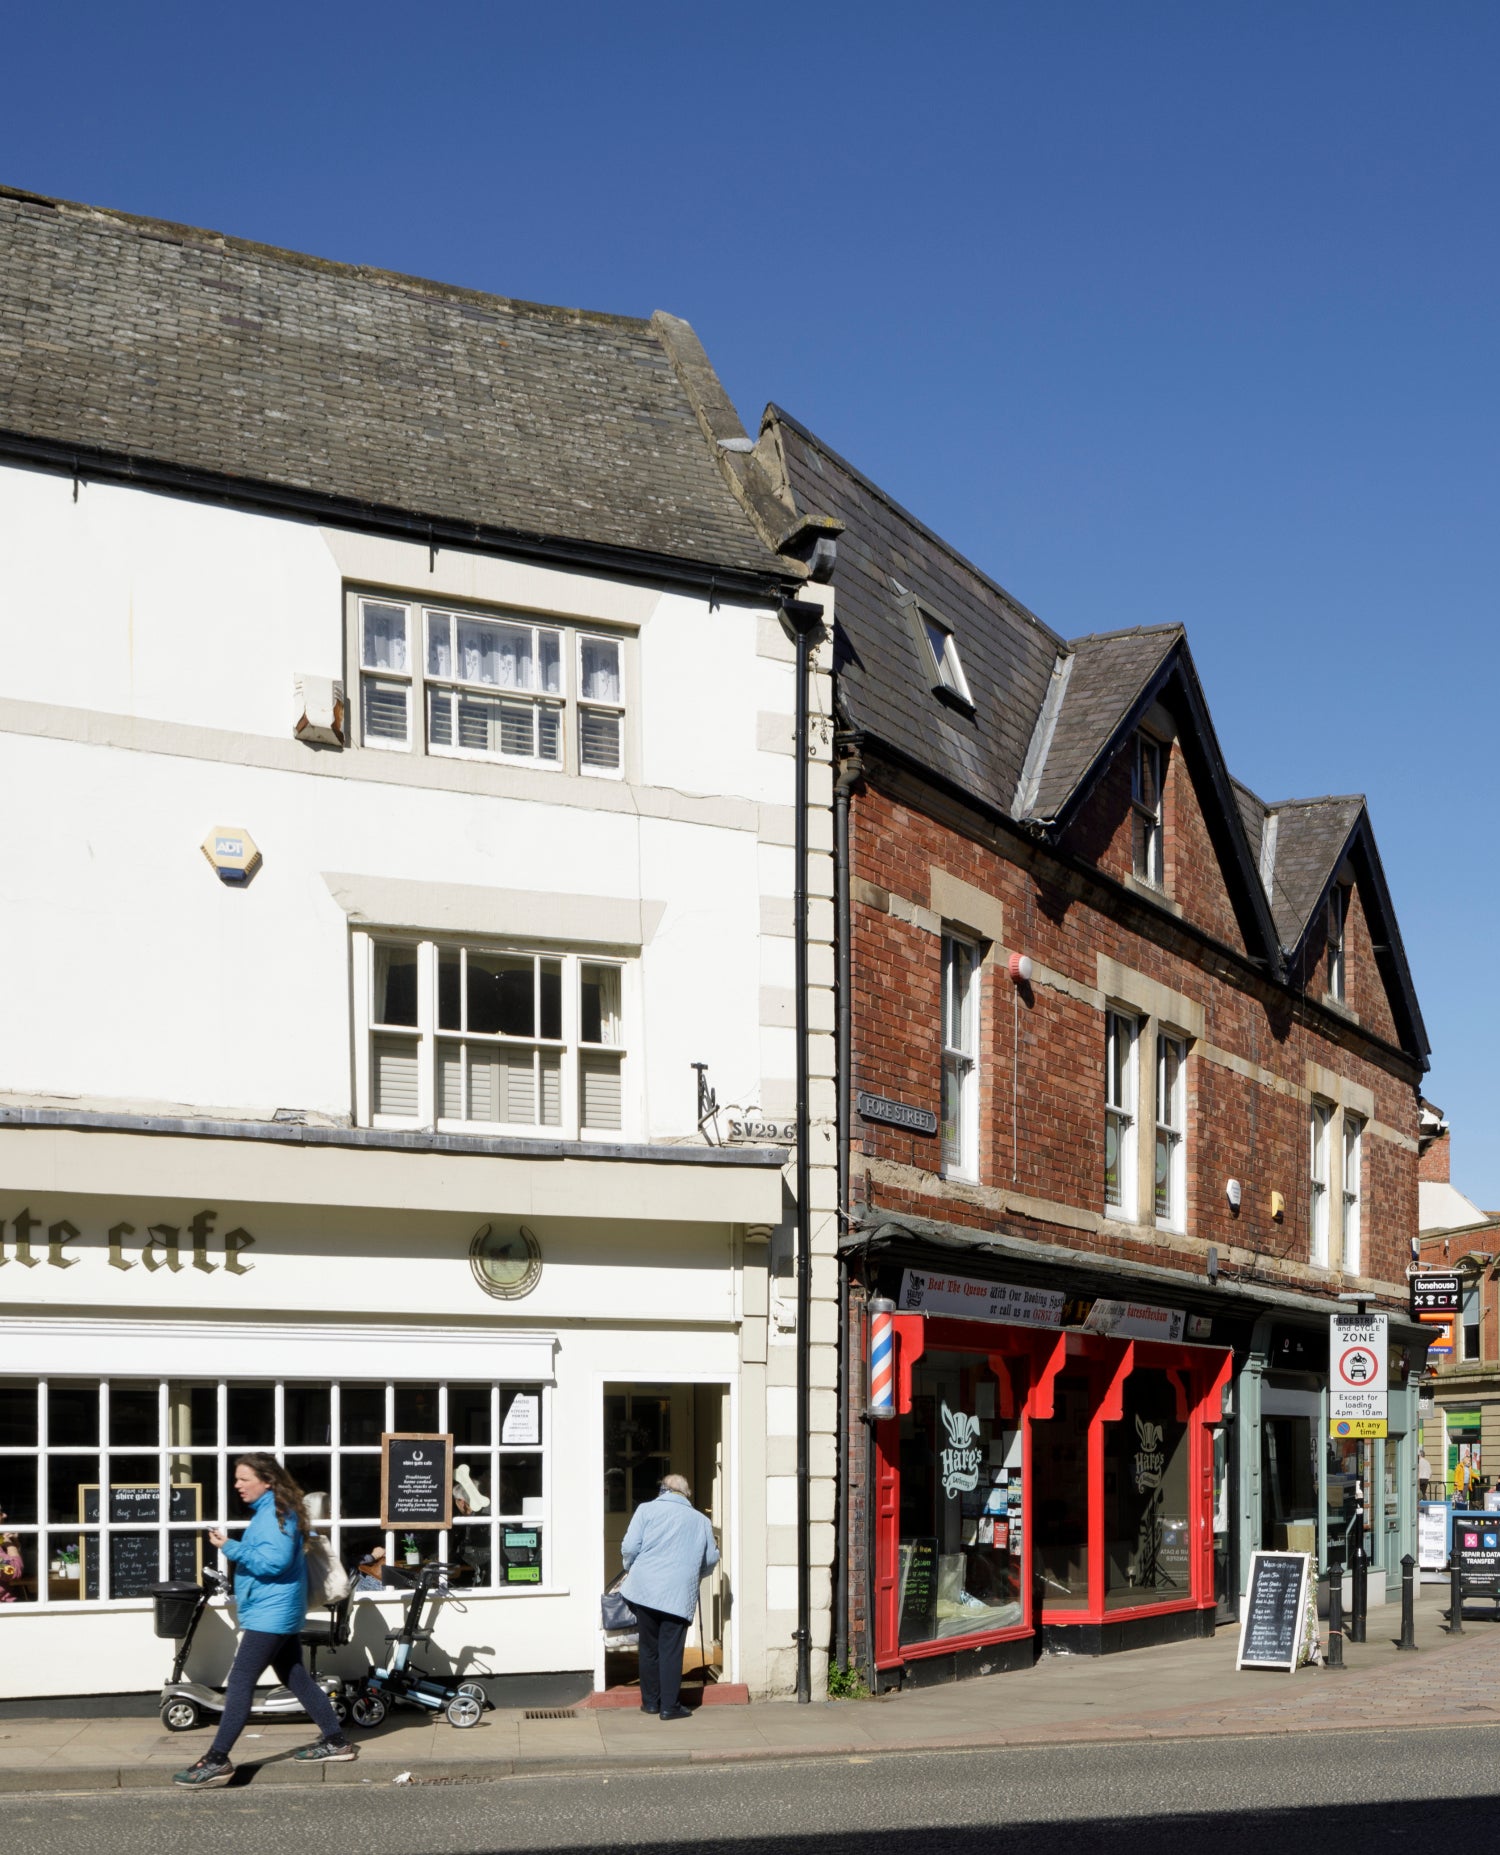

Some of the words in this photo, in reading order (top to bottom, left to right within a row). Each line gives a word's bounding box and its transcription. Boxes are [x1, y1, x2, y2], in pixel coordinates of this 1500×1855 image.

[217, 841, 243, 854] ADT
[866, 1099, 893, 1117] FORE
[894, 1105, 931, 1128] STREET
[0, 1207, 81, 1269] te
[107, 1209, 256, 1276] cafe
[927, 1277, 944, 1291] Beat
[947, 1280, 961, 1293] The
[1417, 1281, 1455, 1290] fonehouse
[1342, 1333, 1375, 1342] ZONE
[940, 1447, 983, 1476] Hare's
[1134, 1451, 1165, 1475] Hare's
[115, 1492, 134, 1500] shire
[135, 1492, 151, 1501] gate
